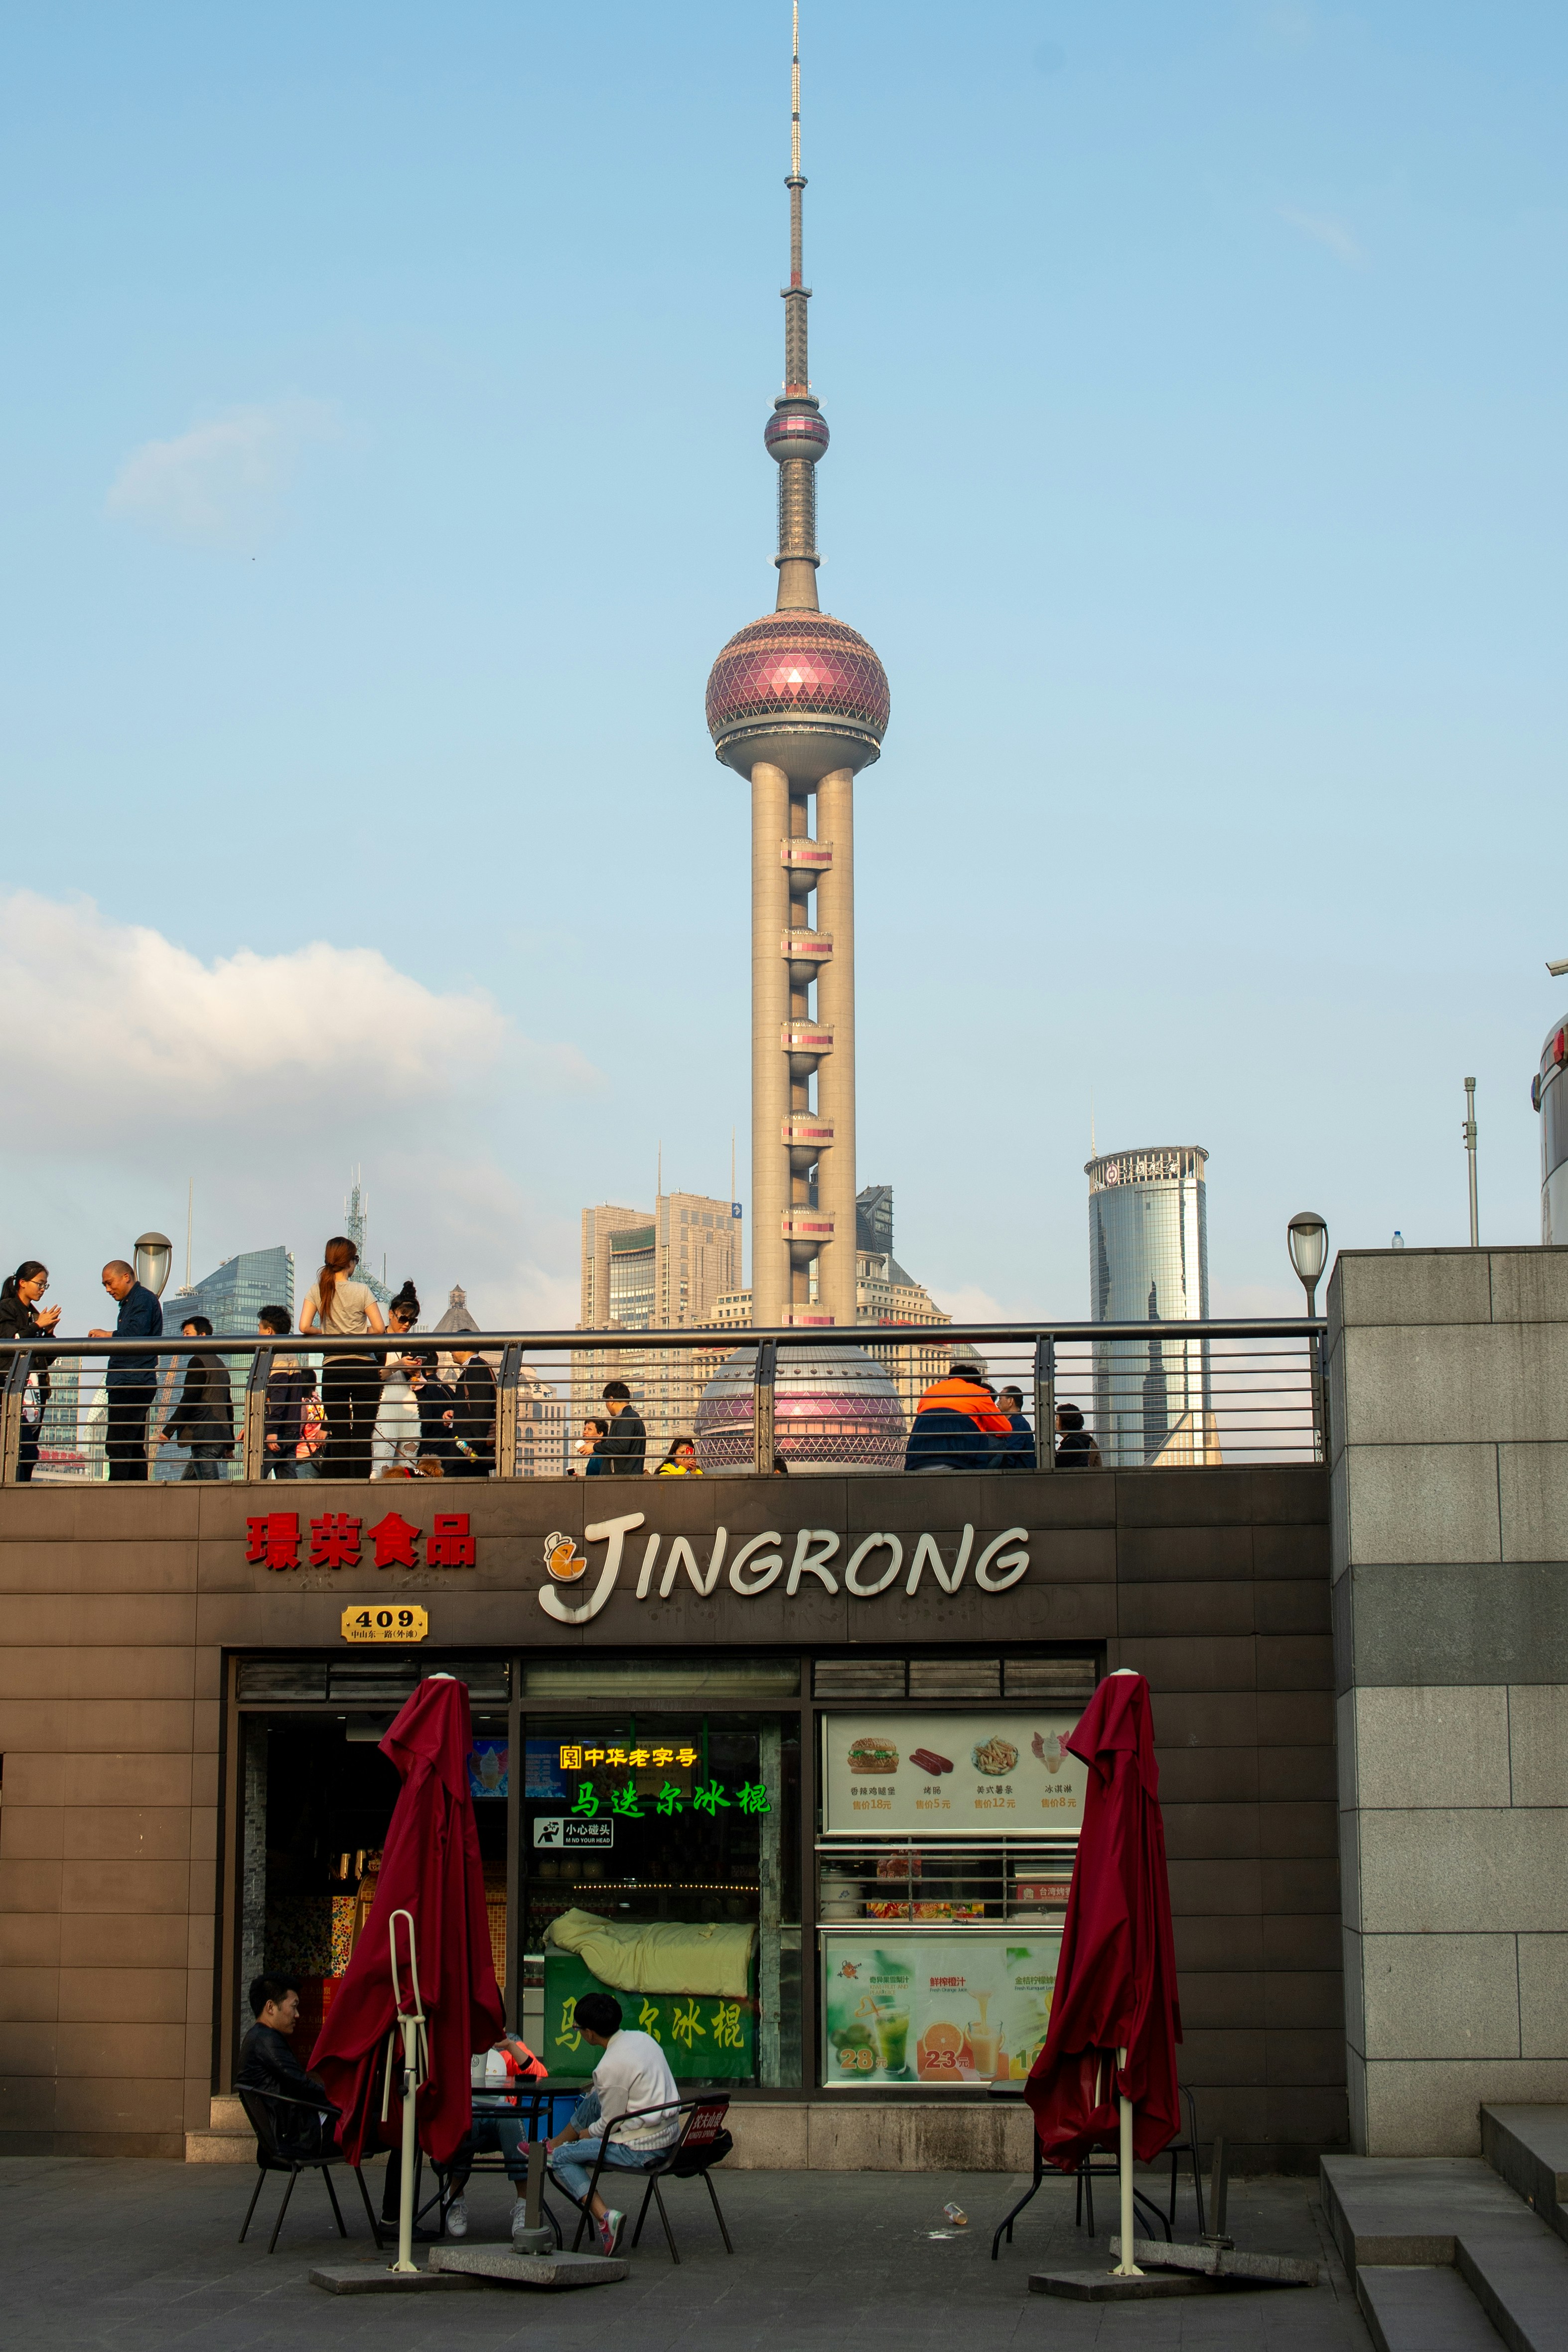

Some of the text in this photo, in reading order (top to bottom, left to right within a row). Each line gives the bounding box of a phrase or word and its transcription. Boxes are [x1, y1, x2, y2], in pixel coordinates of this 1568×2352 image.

[246, 1511, 477, 1570] 璟荣食品
[538, 1511, 1030, 1624] JINGRONG
[355, 1611, 414, 1628] 409
[351, 1629, 419, 1639] 中山东一路(外滩)
[584, 1747, 698, 1767] 中华老字号
[850, 1786, 896, 1796] 香辣鸡腿堡
[923, 1786, 942, 1795] 烤肠
[977, 1785, 1013, 1794] 美式薯条
[1044, 1784, 1073, 1794] 冰淇淋
[571, 1779, 772, 1818] 马迭尔冰棍
[853, 1799, 892, 1810] 售价18元
[566, 1824, 610, 1836] 小心碰头
[930, 1977, 966, 1987] 鲜榨橙汁
[1014, 1976, 1056, 1985] 金桔柠檬蜂
[555, 1996, 744, 2052] 马尔冰棍
[692, 2111, 723, 2130] 农夫山泉
